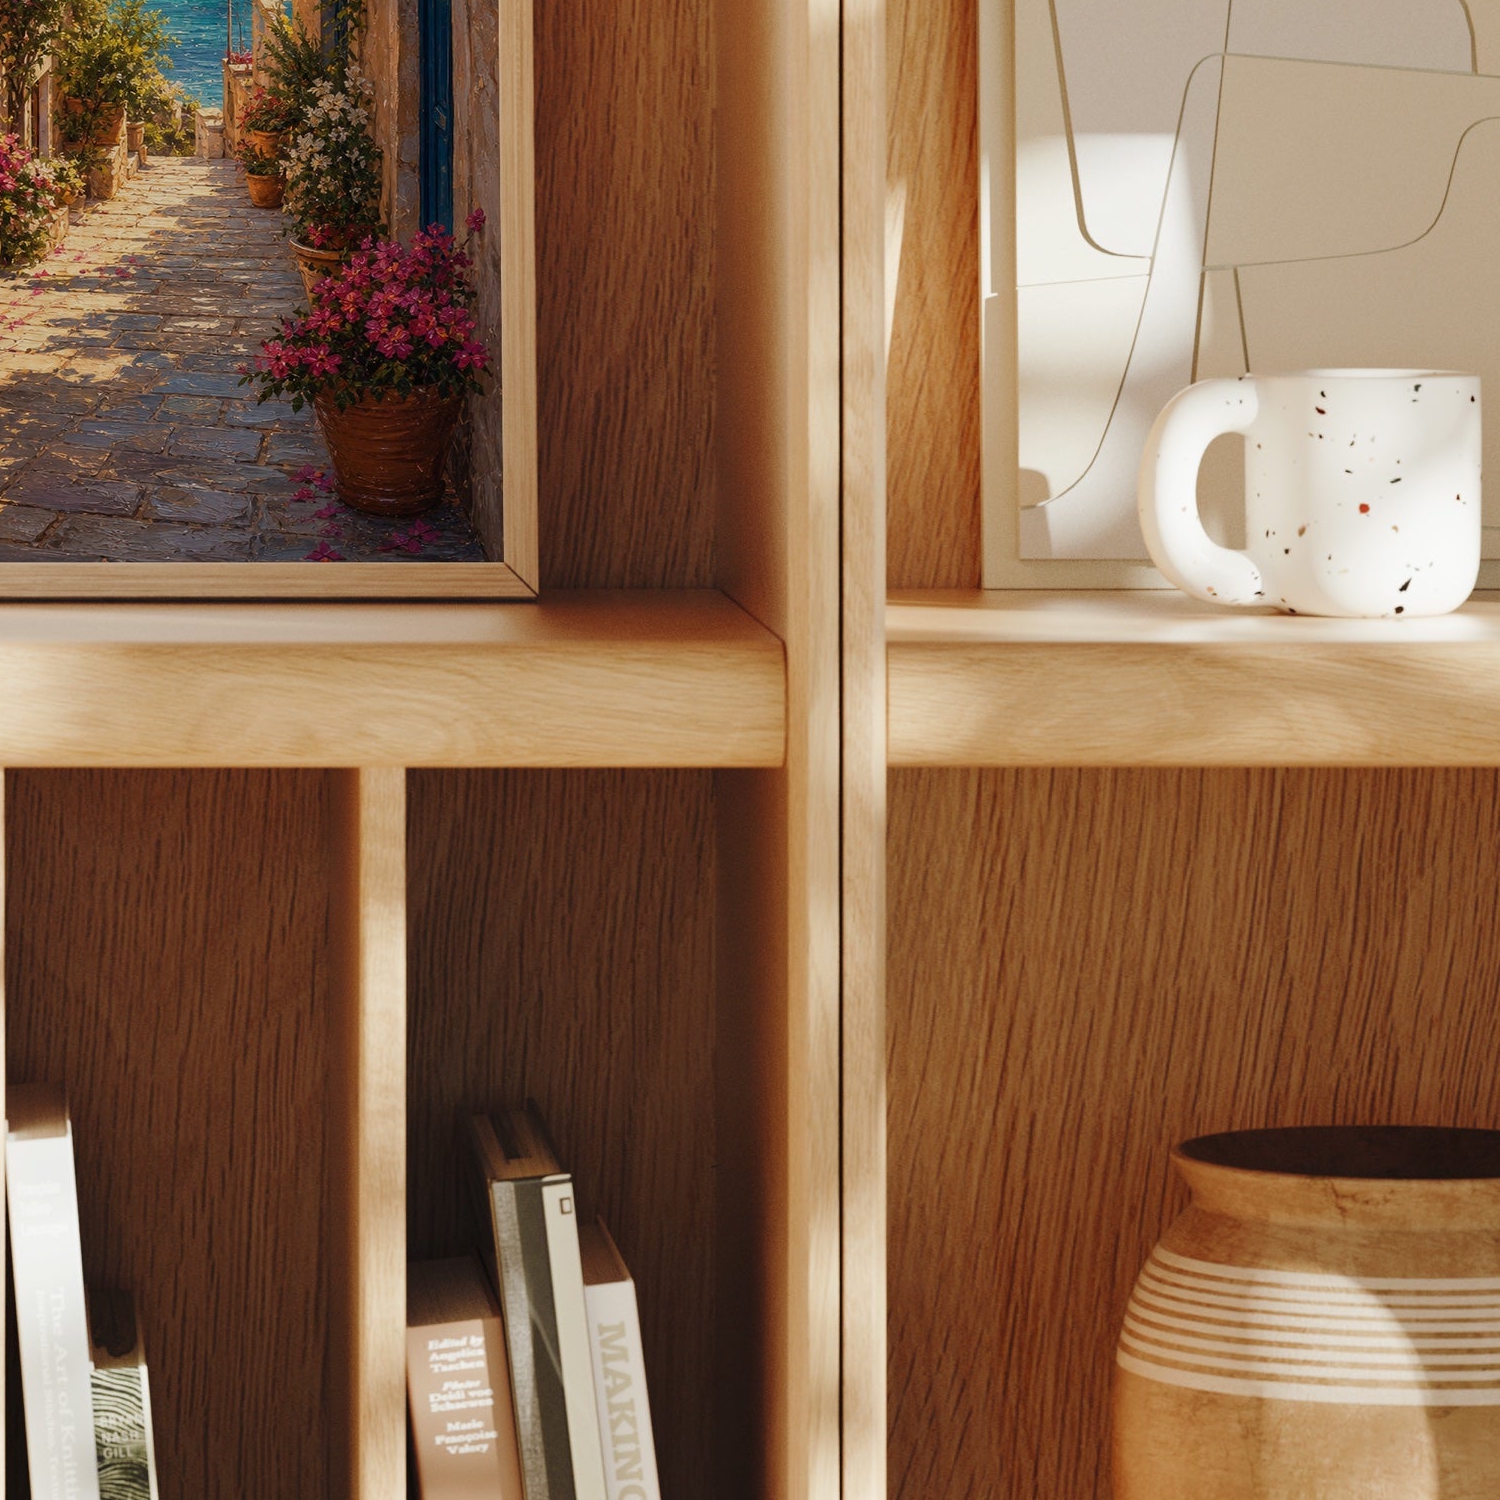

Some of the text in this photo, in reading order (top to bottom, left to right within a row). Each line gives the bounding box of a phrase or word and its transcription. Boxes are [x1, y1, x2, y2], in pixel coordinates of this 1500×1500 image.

[101, 1431, 140, 1443] NASH
[103, 1446, 133, 1459] GILL
[60, 1424, 80, 1500] Knitti
